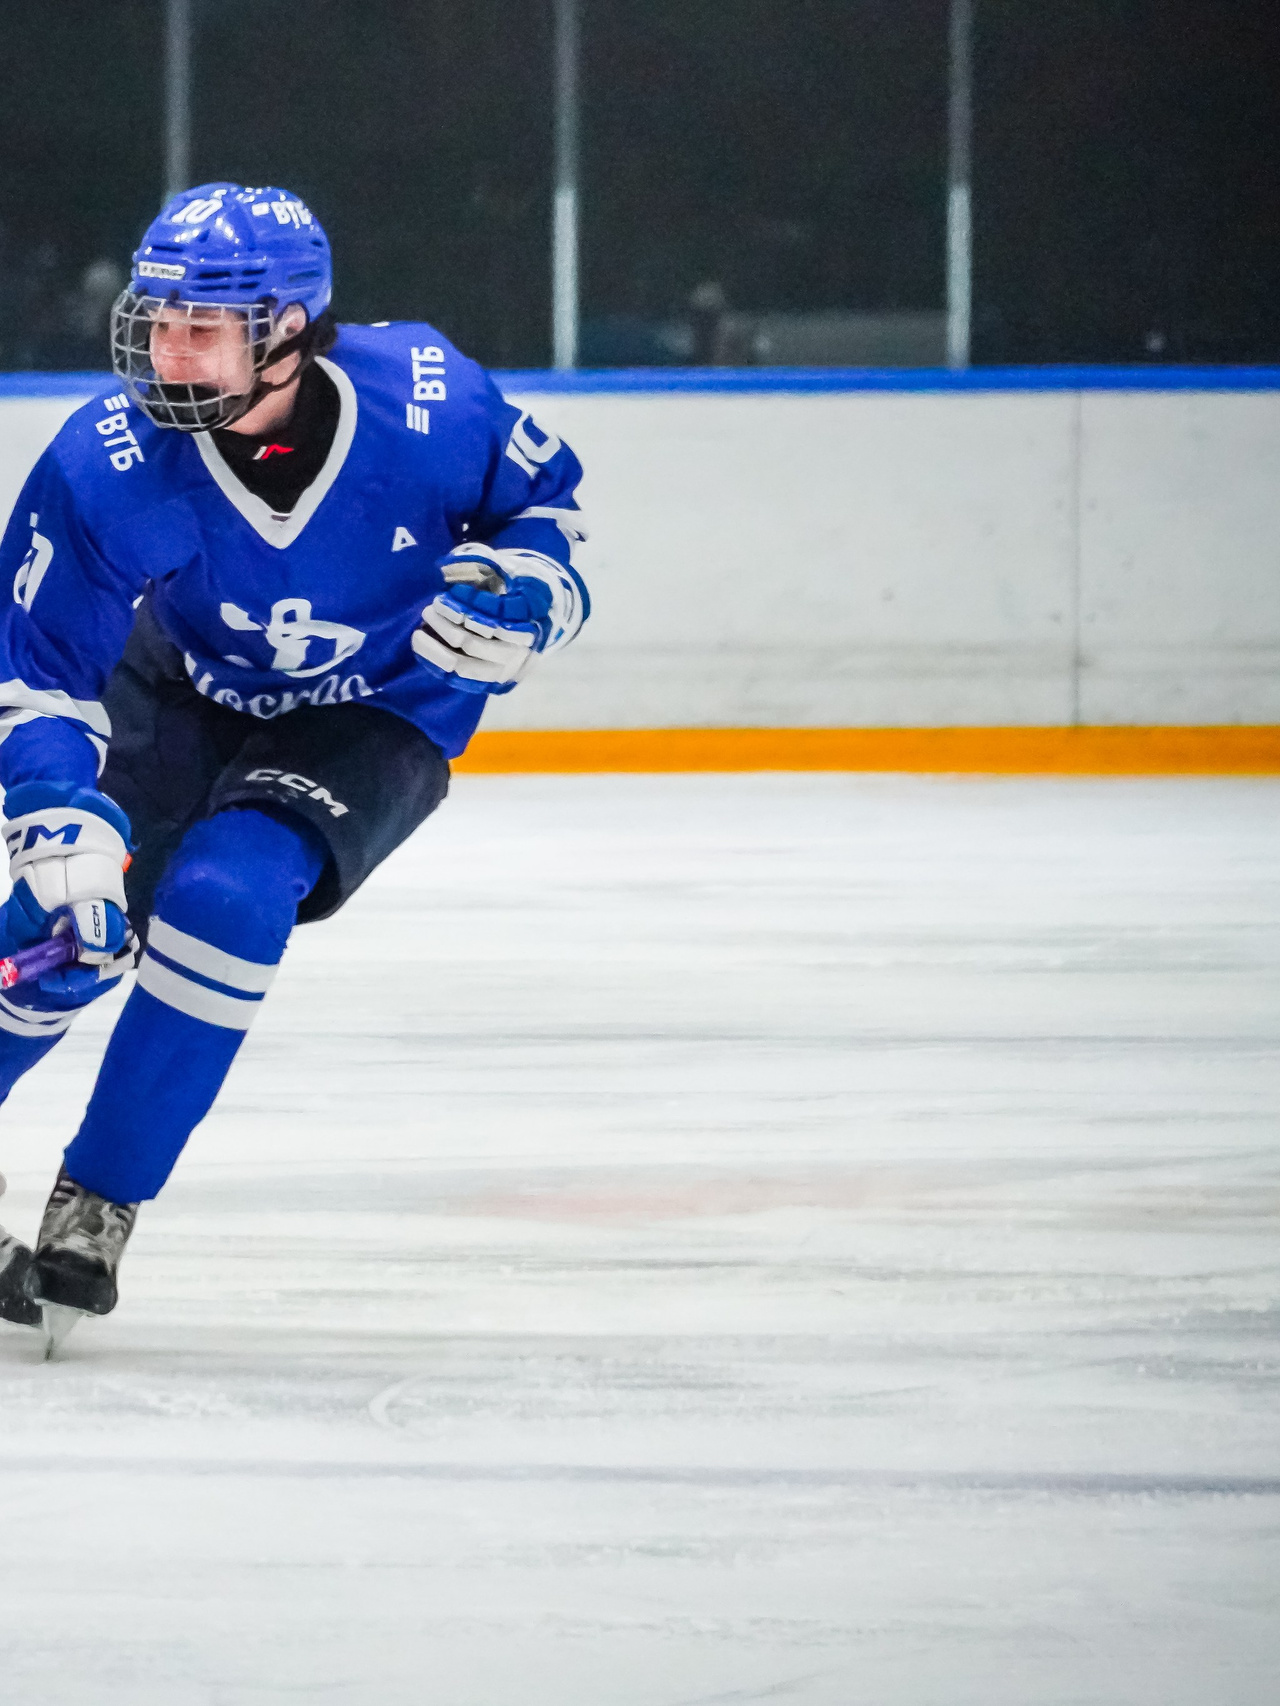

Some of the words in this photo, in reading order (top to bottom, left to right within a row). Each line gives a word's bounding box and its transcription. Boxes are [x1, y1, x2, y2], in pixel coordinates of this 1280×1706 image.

[171, 198, 224, 224] 10
[410, 345, 447, 401] ВТБ
[95, 411, 145, 471] ВТБ
[505, 411, 562, 480] 10
[391, 526, 418, 552] A
[245, 768, 349, 818] CCM
[6, 823, 83, 860] CM
